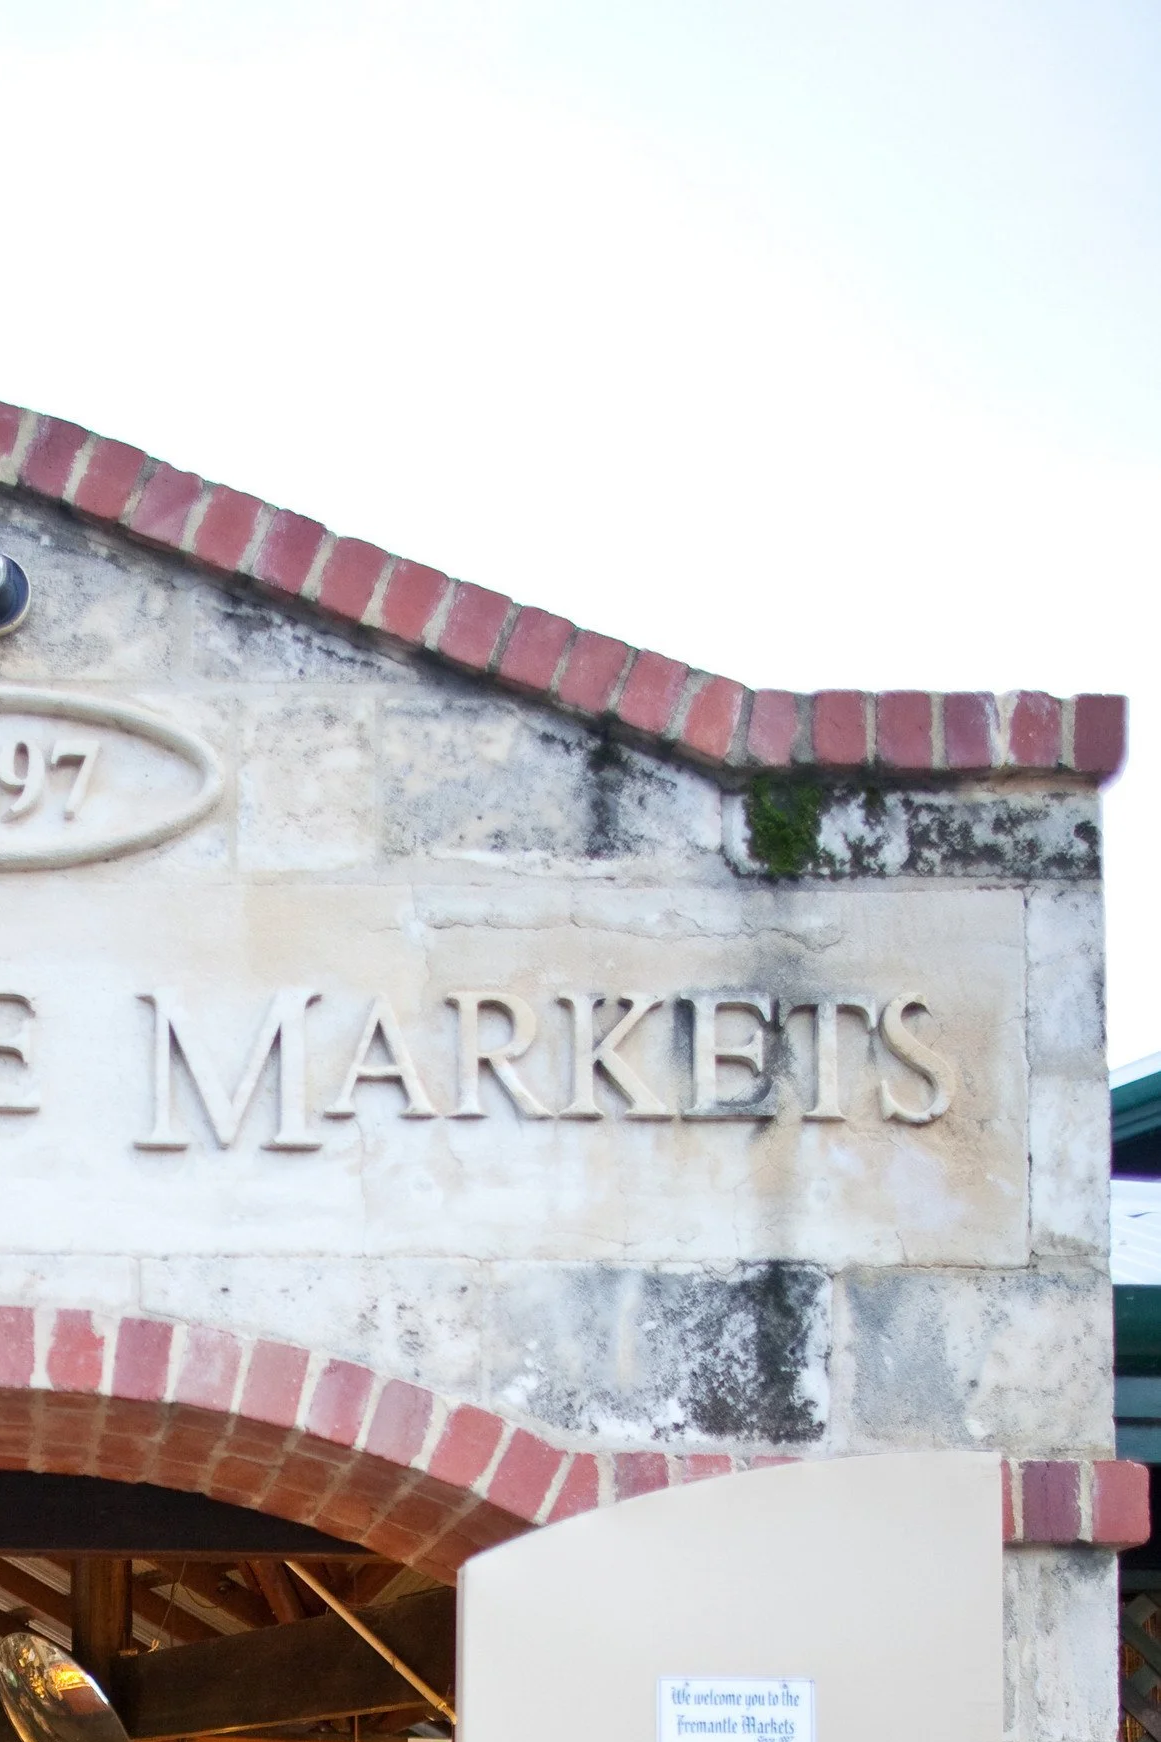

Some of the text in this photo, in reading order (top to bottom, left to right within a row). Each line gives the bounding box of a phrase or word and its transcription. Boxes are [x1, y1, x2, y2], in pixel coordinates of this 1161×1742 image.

[133, 984, 957, 1153] MARKETS
[671, 1687, 800, 1710] We welcome you to the
[677, 1715, 794, 1735] Fremantle Markets
